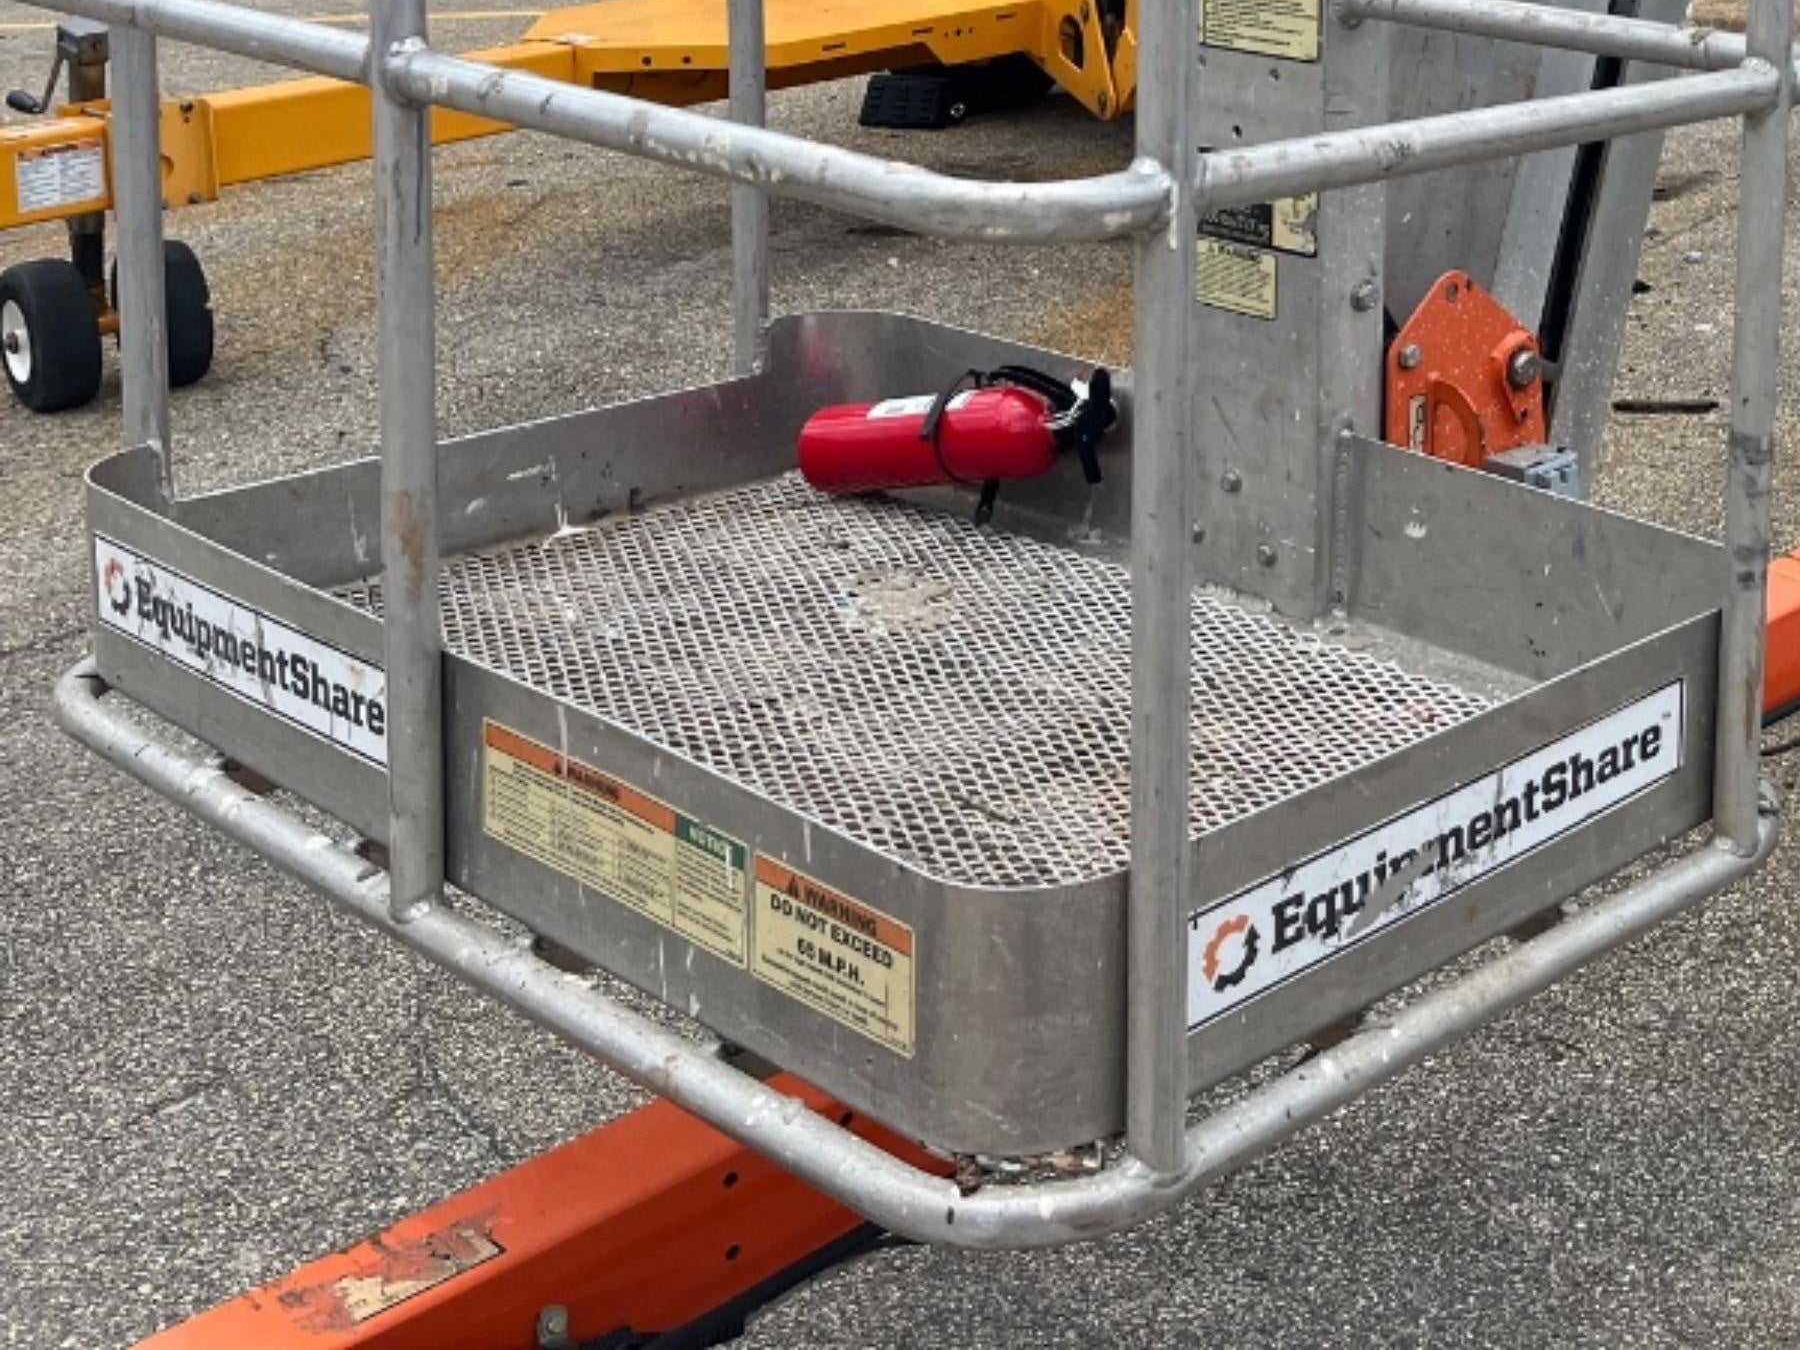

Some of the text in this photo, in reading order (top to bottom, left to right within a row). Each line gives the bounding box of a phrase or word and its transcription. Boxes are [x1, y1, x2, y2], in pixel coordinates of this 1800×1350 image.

[134, 574, 385, 736] EquipmentShare
[770, 893, 894, 970] DO NOT EXCEED
